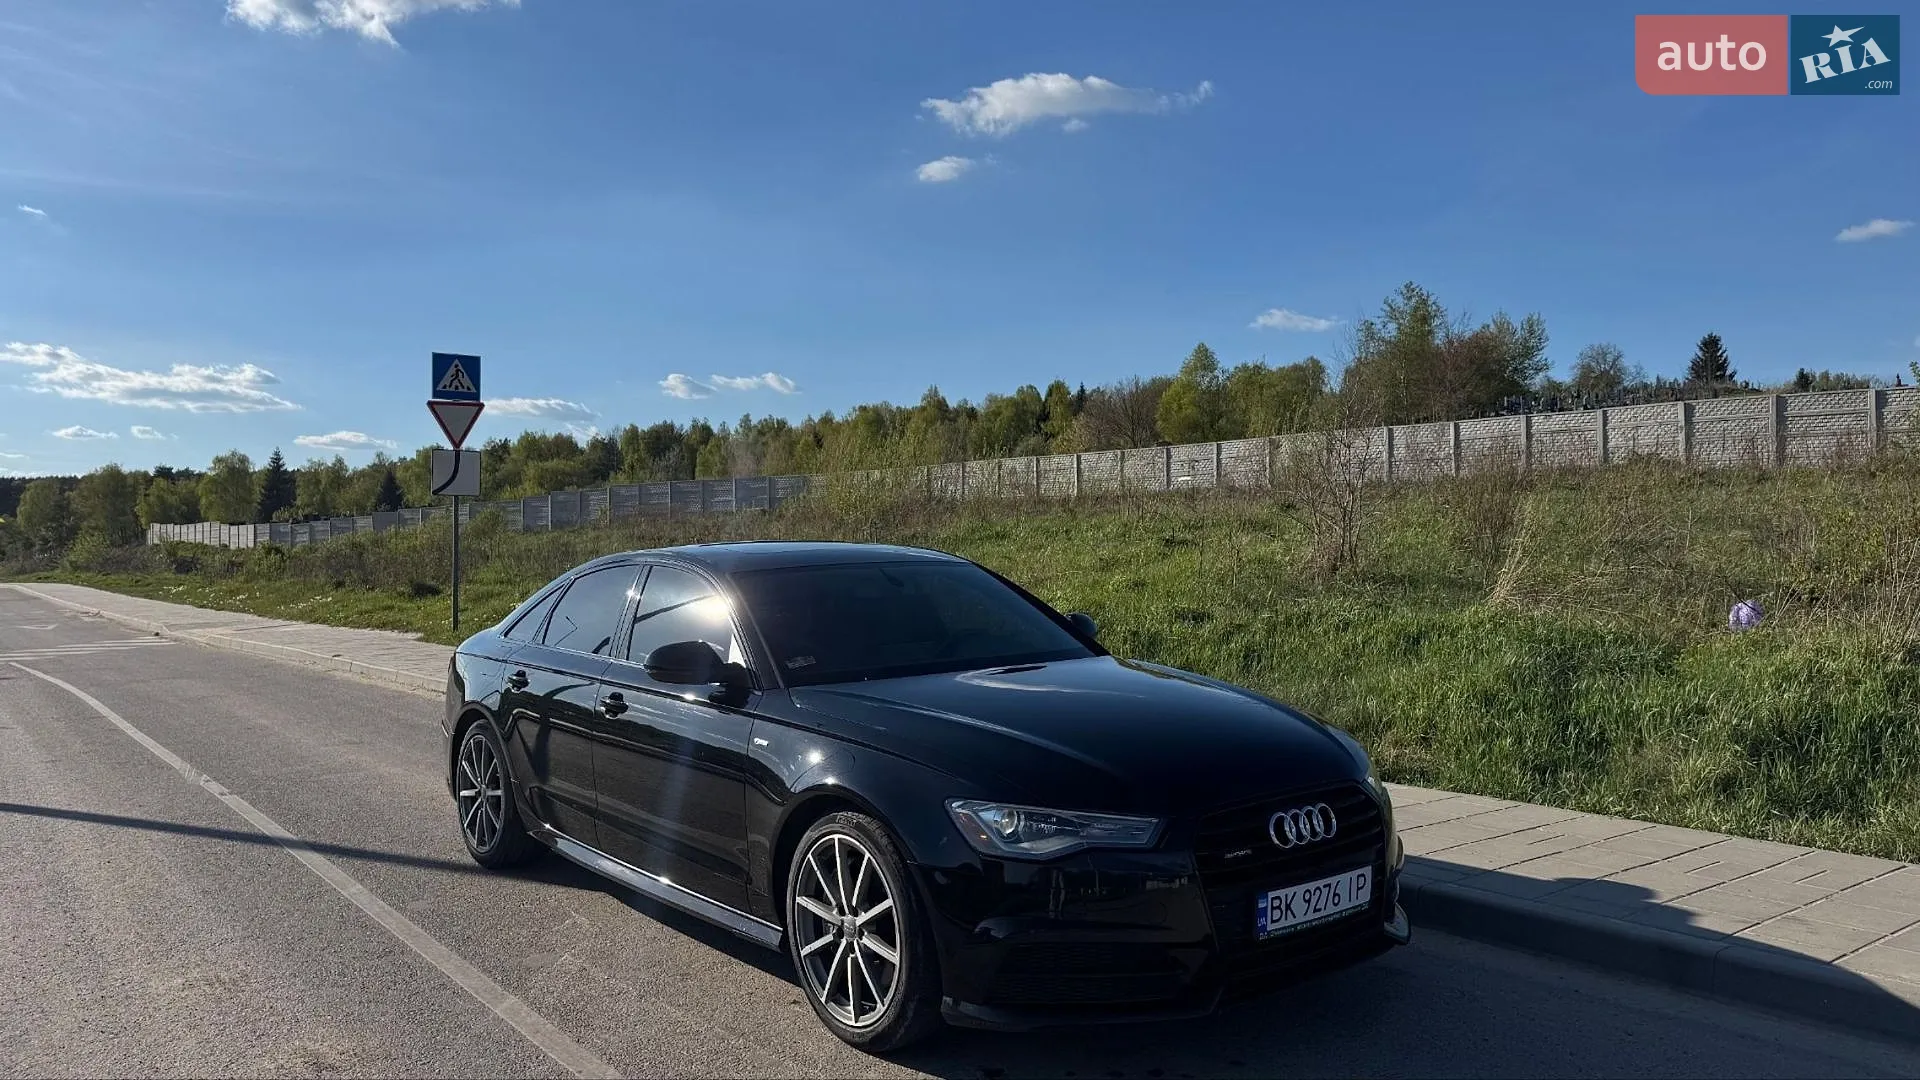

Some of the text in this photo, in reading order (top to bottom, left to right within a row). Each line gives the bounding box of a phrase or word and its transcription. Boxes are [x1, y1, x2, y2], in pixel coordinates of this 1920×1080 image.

[1270, 891, 1296, 924] BK
[1302, 880, 1341, 917] 9276
[1348, 873, 1367, 903] IP
